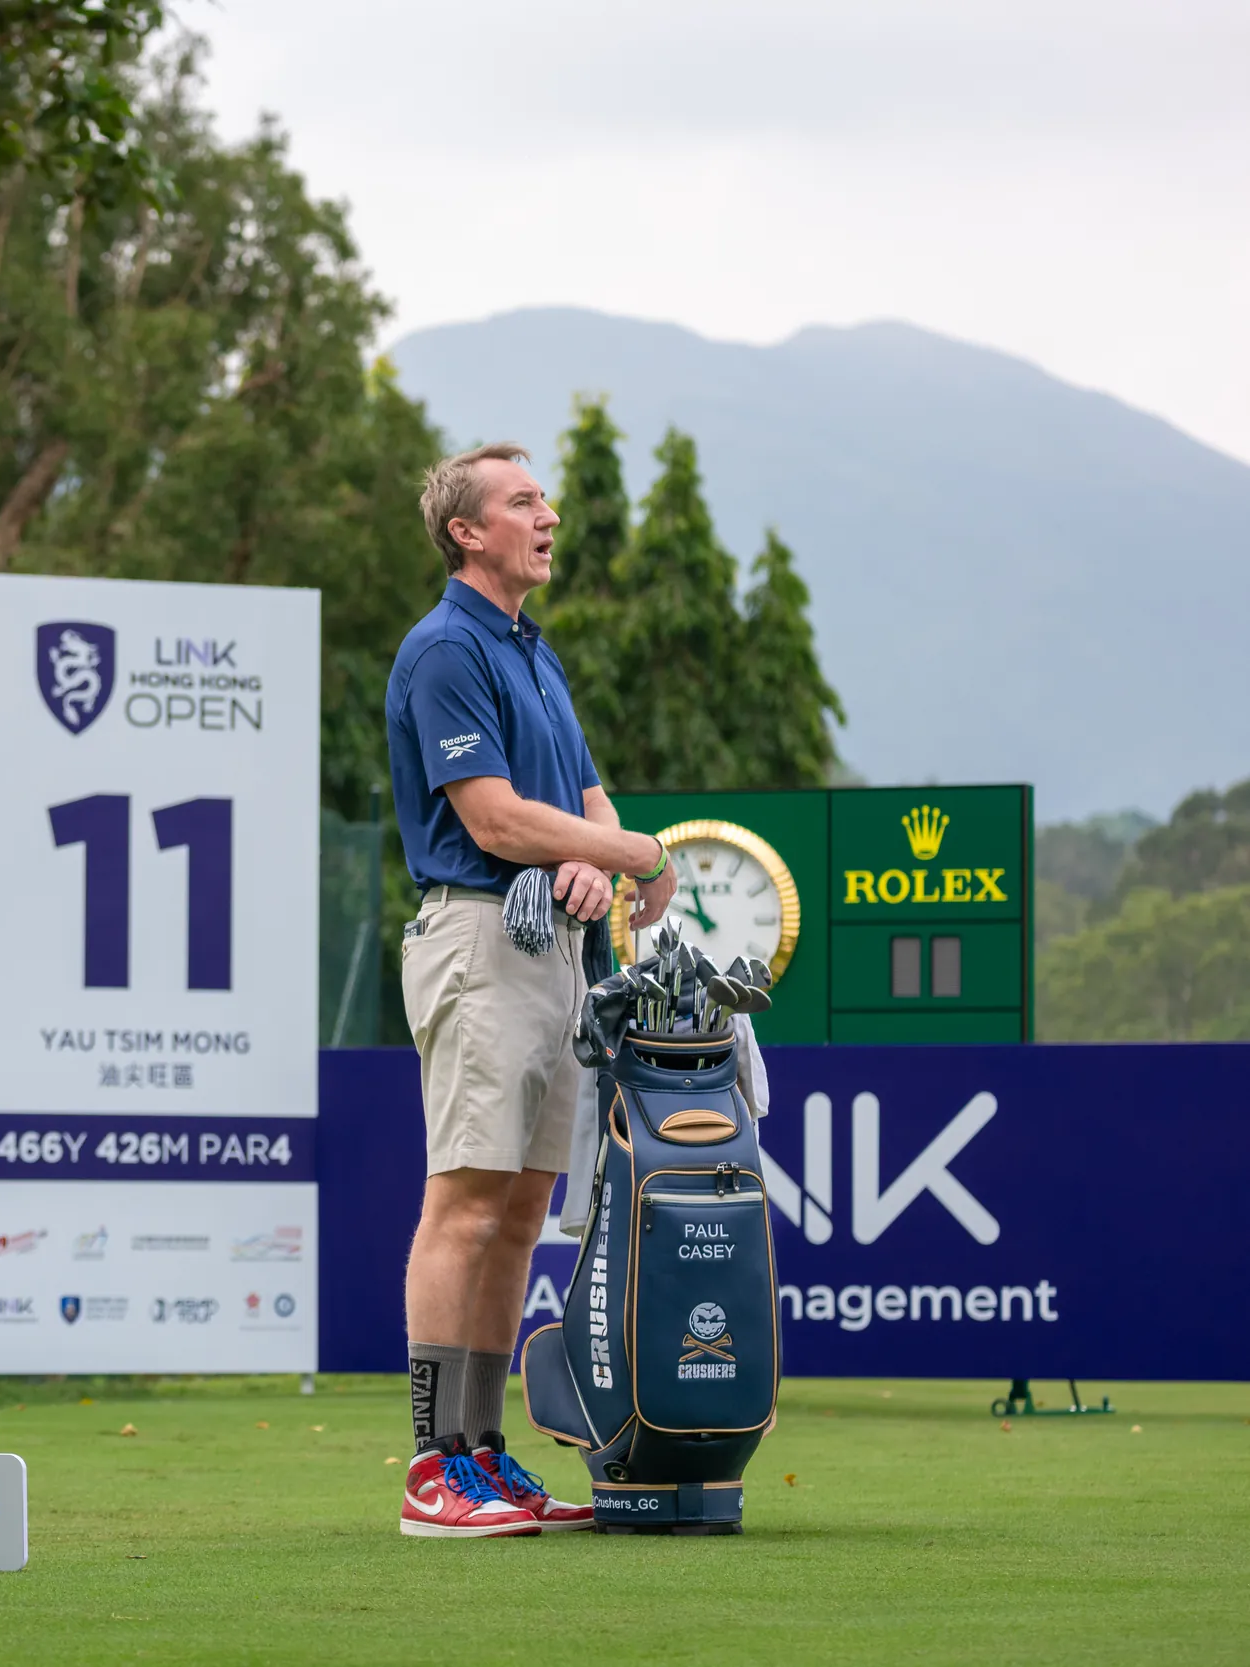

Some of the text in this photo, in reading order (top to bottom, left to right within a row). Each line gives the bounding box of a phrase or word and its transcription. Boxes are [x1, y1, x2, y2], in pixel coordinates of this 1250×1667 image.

[155, 636, 237, 668] LINK
[130, 672, 263, 692] HONG KONG
[125, 692, 263, 732] OPEN
[439, 732, 481, 749] Reebok
[47, 794, 233, 990] 11
[843, 868, 1009, 904] ROLEX
[40, 1029, 252, 1055] YAU TSIM MONG
[98, 1063, 195, 1089] 油尖旺區
[94, 1131, 189, 1164] 426M
[199, 1133, 292, 1166] PAR4
[684, 1223, 730, 1239] PAUL
[678, 1244, 736, 1259] CASEY
[589, 1181, 613, 1390] CRUSHERS
[778, 1279, 1059, 1331] nagement
[677, 1363, 736, 1379] CRUSHERS
[411, 1361, 433, 1451] STANCE
[592, 1495, 659, 1512] Crushers_GC
